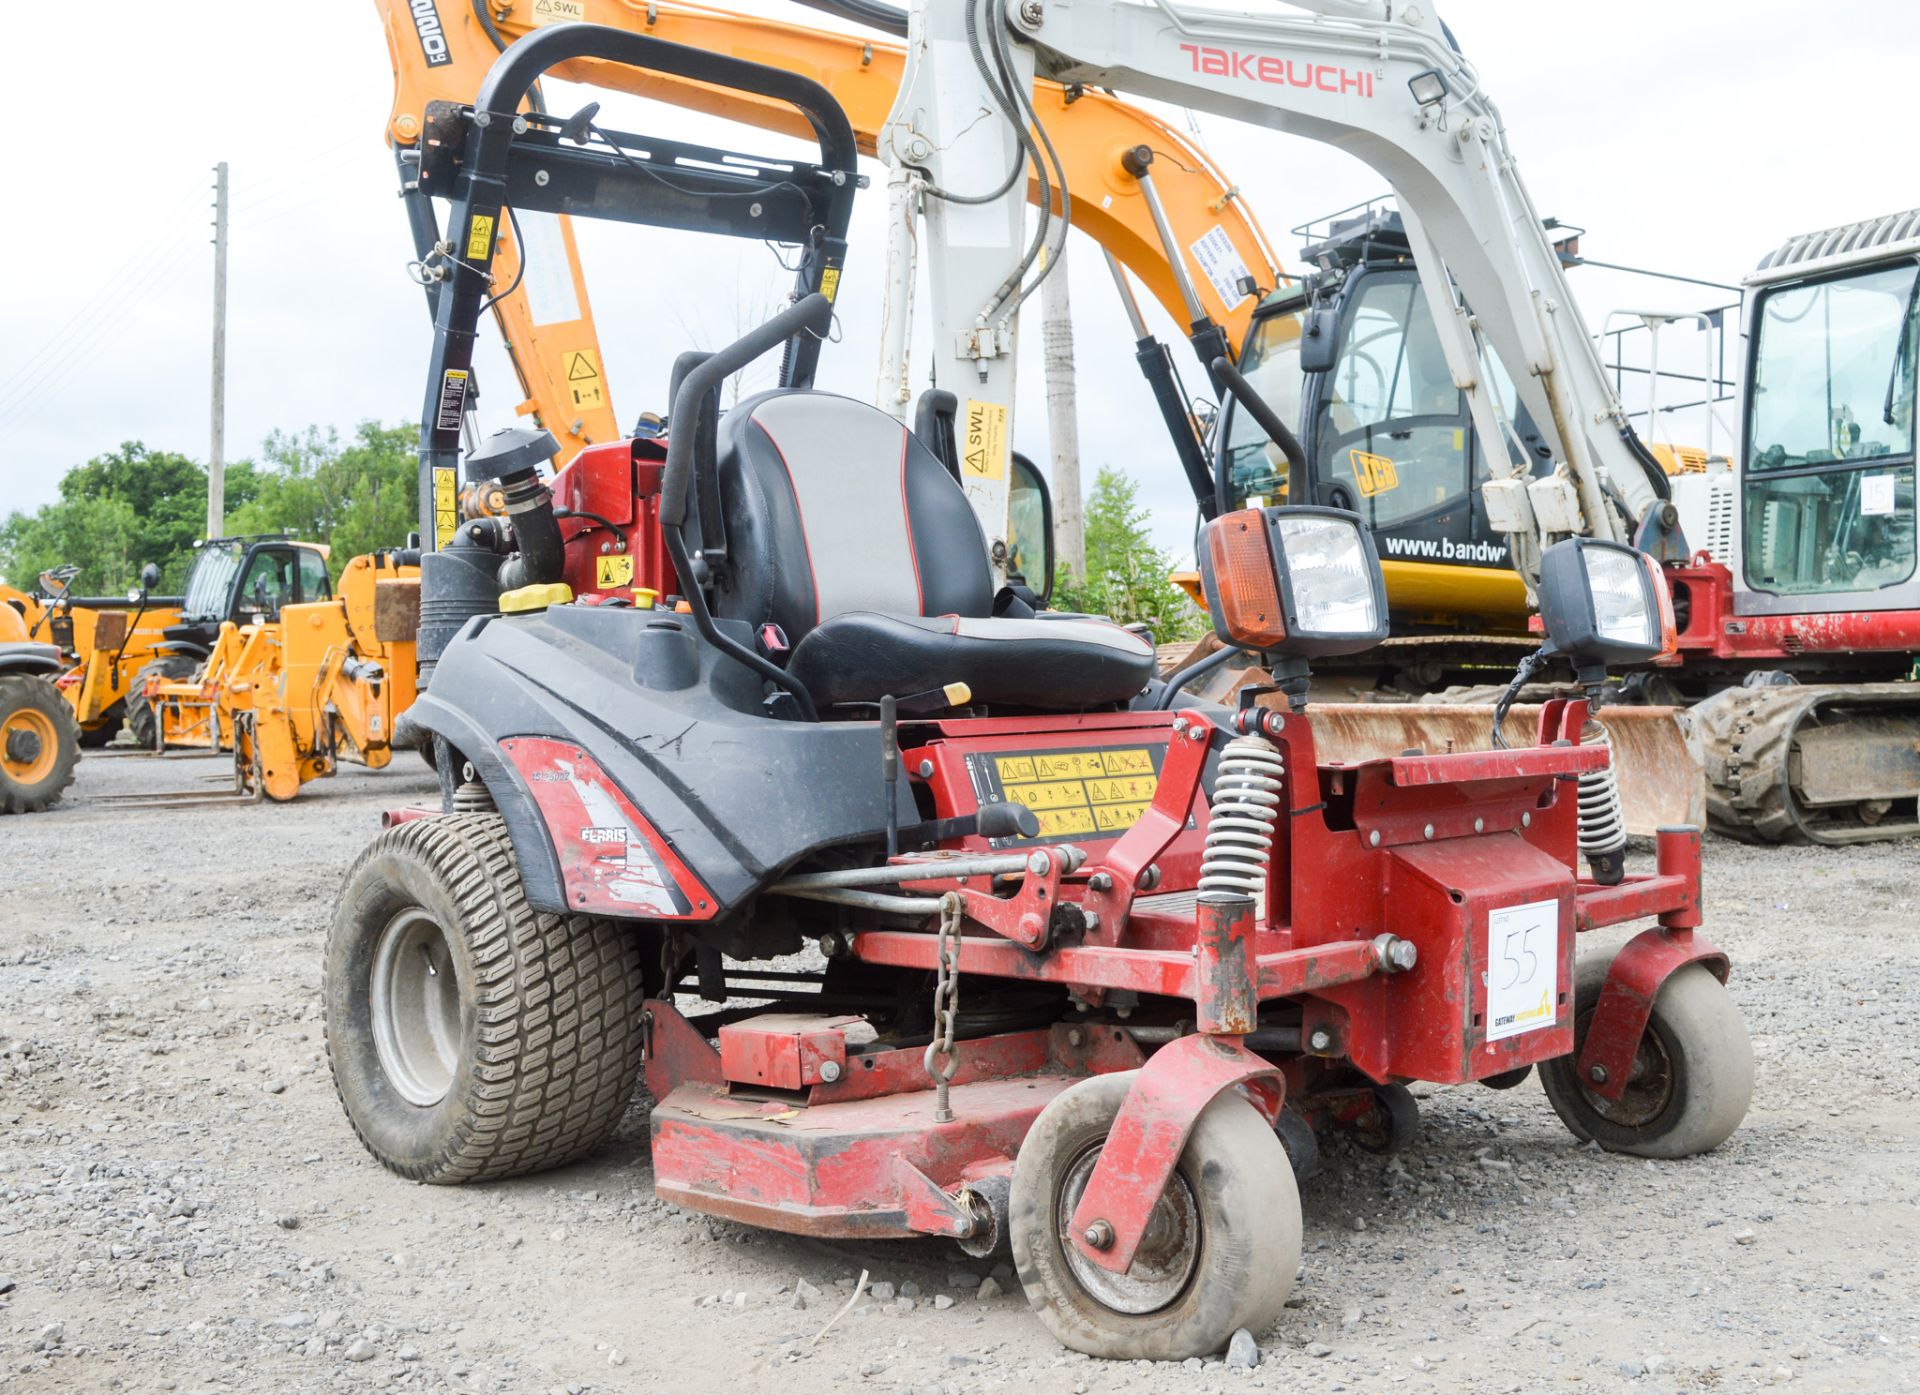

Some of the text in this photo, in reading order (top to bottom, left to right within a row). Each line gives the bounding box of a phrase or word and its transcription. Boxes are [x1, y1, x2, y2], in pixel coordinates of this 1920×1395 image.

[553, 1, 581, 15] SWL
[1179, 43, 1373, 98] TAKEUCHI
[969, 406, 984, 446] SWL
[1358, 455, 1395, 493] JCB
[1500, 924, 1541, 990] 55
[1494, 1014, 1515, 1027] GATEWAY
